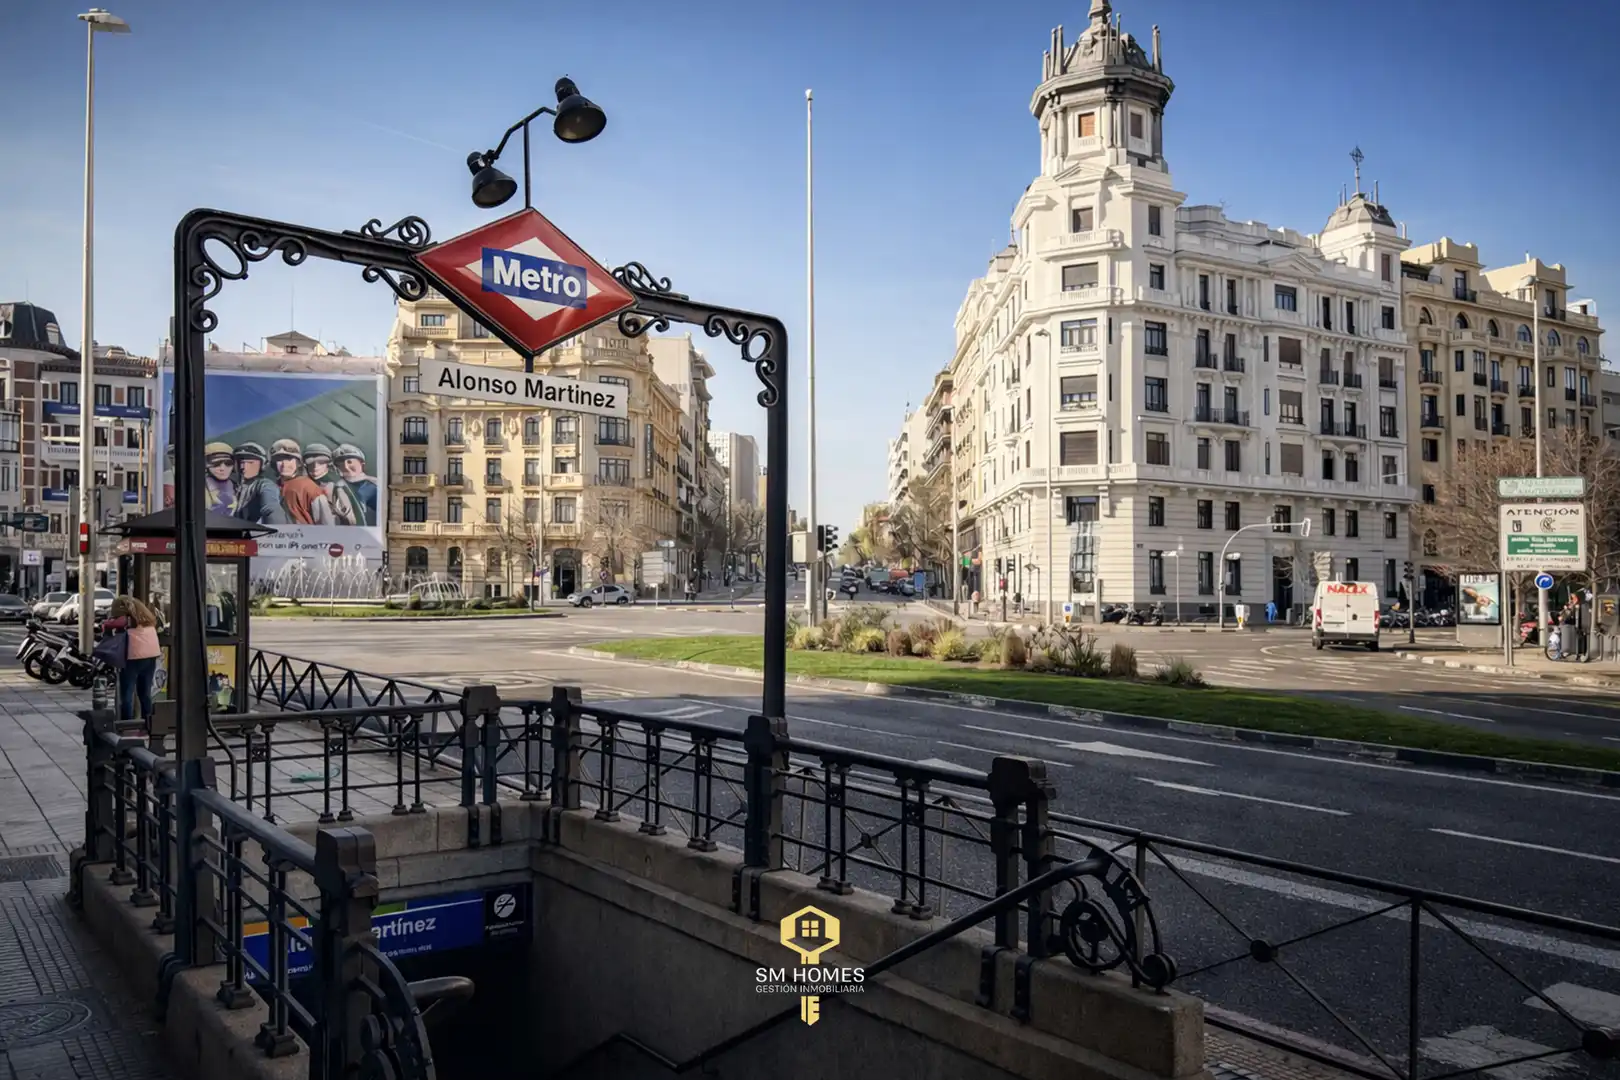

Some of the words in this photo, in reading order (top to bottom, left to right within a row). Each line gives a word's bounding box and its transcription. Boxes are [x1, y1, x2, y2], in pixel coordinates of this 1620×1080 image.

[493, 256, 581, 298] Metro
[438, 368, 517, 395] Alonso
[525, 379, 615, 409] Martinez
[371, 917, 436, 939] artínez
